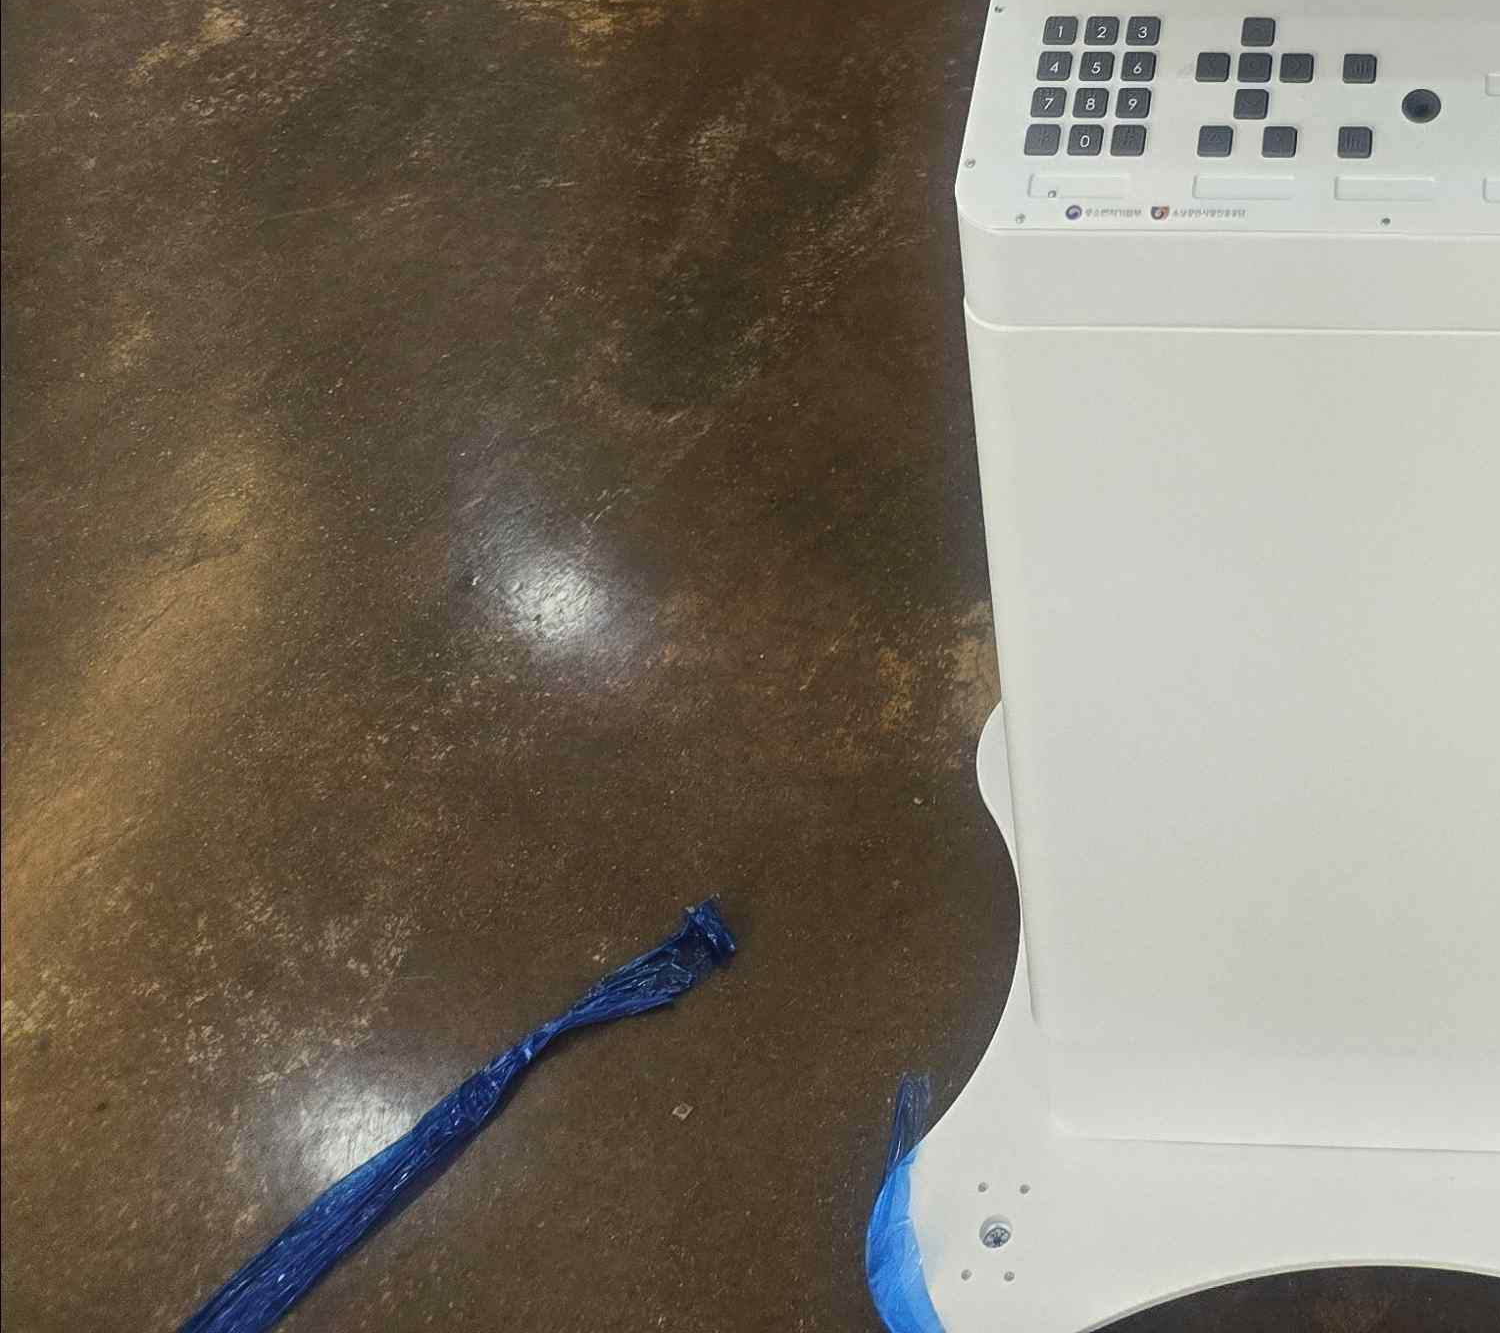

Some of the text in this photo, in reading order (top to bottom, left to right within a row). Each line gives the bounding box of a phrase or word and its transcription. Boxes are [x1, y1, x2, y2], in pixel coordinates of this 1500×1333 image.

[1096, 26, 1107, 38] 2
[1137, 26, 1148, 38] 3
[1050, 61, 1059, 73] 4
[1091, 61, 1102, 74] 5
[1133, 62, 1142, 74] 6
[1044, 97, 1054, 110] 7
[1085, 97, 1096, 110] 8
[1128, 98, 1138, 110] 9
[1079, 134, 1091, 148] 0
